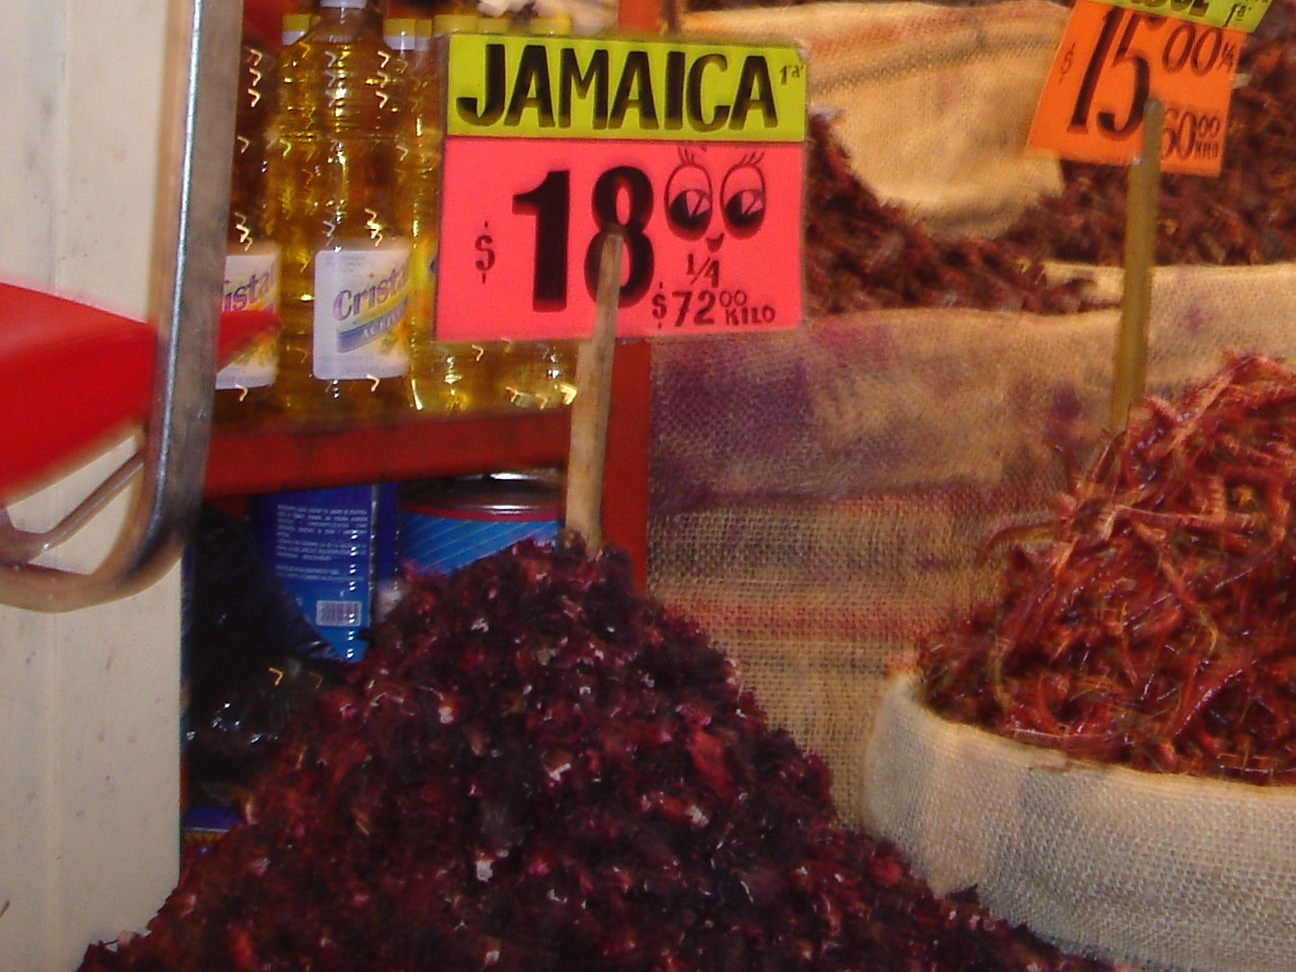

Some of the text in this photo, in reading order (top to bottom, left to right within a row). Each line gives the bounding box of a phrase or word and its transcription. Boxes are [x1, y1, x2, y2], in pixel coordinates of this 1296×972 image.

[456, 44, 778, 132] JAMAICA
[474, 221, 496, 284] $
[725, 305, 776, 326] KILO
